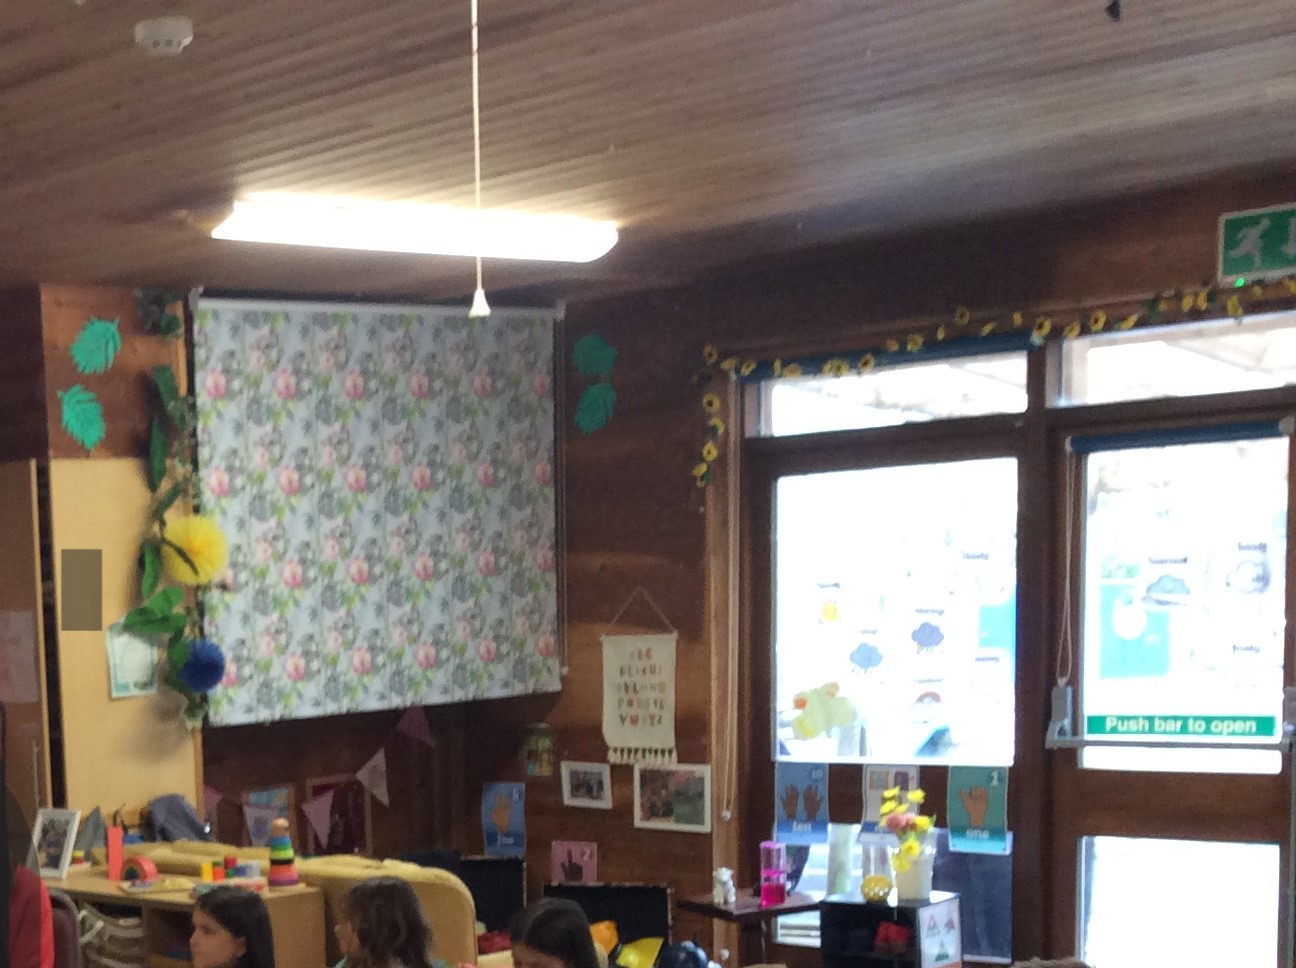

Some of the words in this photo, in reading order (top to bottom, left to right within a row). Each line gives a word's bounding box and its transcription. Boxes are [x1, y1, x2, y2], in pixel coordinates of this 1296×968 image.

[1105, 716, 1150, 732] Push
[1154, 716, 1183, 733] bar
[1187, 717, 1206, 733] to
[1209, 719, 1257, 736] open
